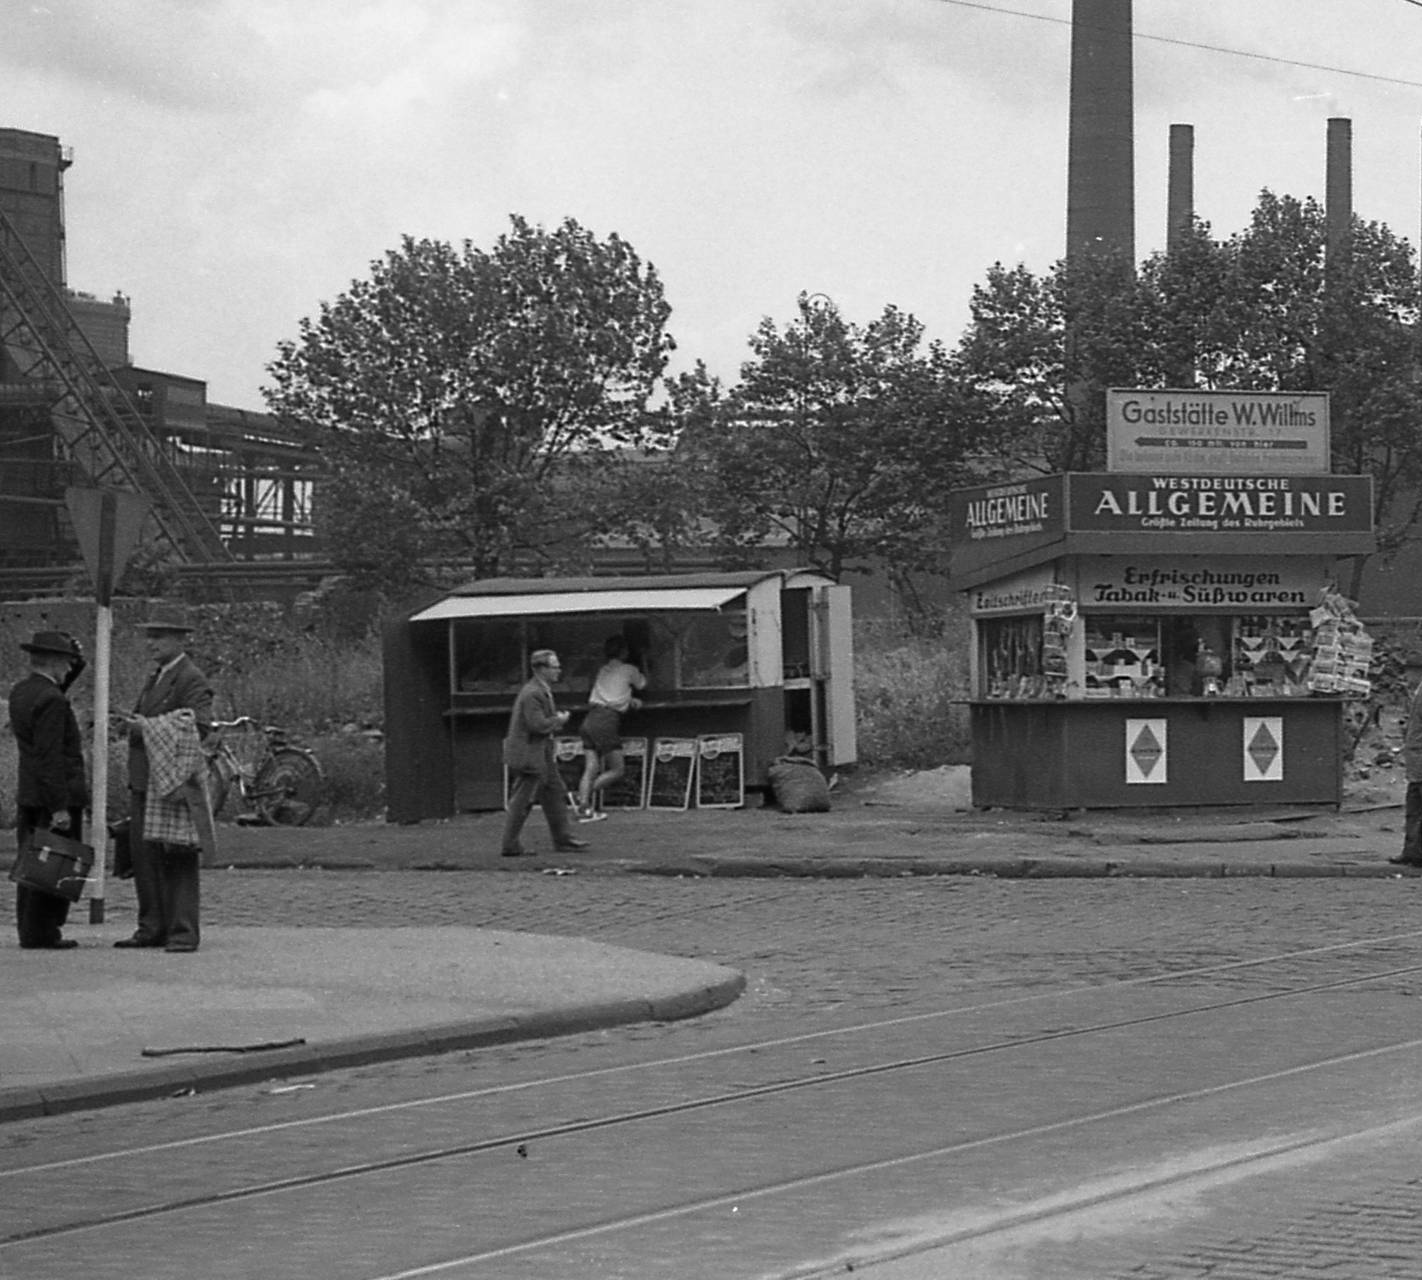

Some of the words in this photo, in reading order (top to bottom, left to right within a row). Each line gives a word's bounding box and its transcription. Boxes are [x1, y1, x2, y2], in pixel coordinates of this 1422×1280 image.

[1121, 400, 1229, 425] Gaststätte
[1253, 439, 1275, 450] hier
[1152, 477, 1290, 491] WESTDEUTSCHE
[964, 492, 1049, 527] ALLGEMEINE
[1093, 490, 1347, 517] ALLGEMEINE
[1140, 517, 1176, 529] Größte
[1179, 517, 1218, 530] Zeitung
[1221, 518, 1240, 528] des
[1244, 518, 1305, 531] Ruhrgebiets
[1123, 566, 1281, 588] Erfrischungen
[1182, 584, 1307, 604] Süßwaren
